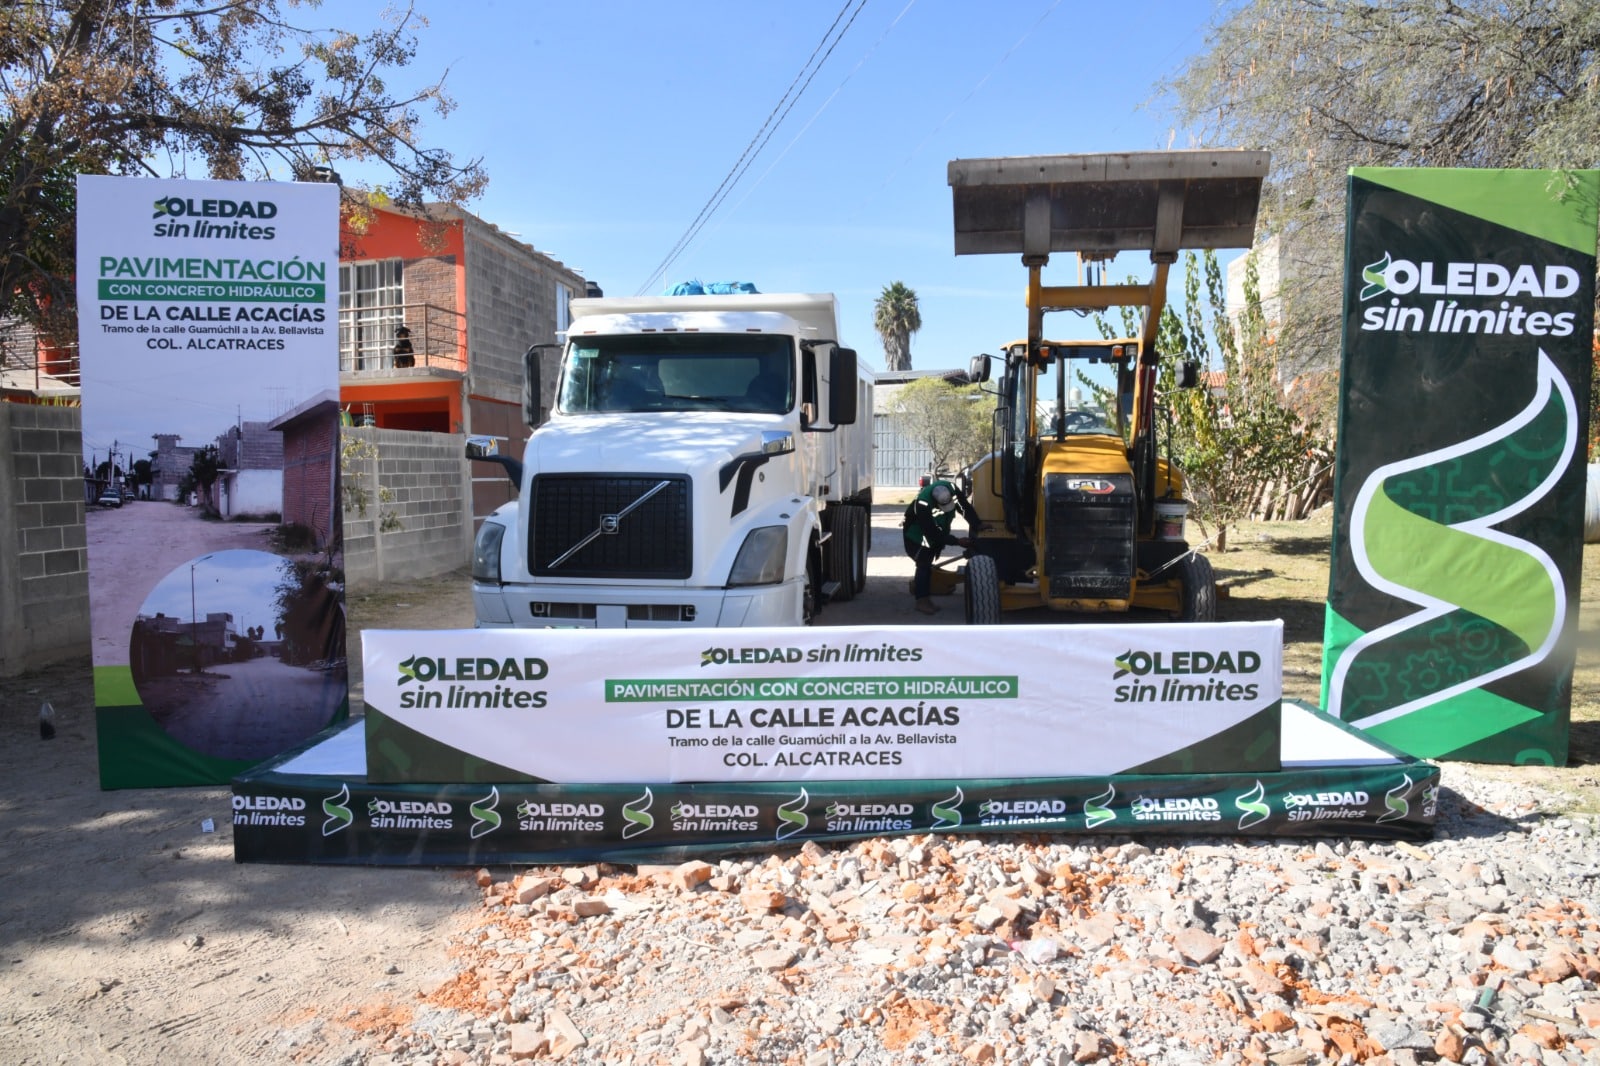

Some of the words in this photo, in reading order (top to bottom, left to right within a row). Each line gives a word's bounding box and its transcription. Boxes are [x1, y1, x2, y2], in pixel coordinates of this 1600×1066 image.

[152, 195, 278, 219] SOLEDAD
[153, 219, 190, 238] sin
[193, 221, 276, 241] límites
[99, 255, 326, 282] PAVIMENTACIÓN
[1360, 250, 1581, 302] SOLEDAD
[108, 283, 142, 296] CON
[144, 284, 226, 297] CONCRETO
[228, 283, 316, 298] HIDRÁULICO
[100, 305, 129, 321] DE
[133, 306, 161, 321] LA
[165, 306, 231, 322] CALLE
[234, 304, 326, 322] ACACÍAS
[1361, 297, 1425, 332] sin
[1428, 300, 1576, 337] límites
[101, 324, 135, 334] Tramo
[135, 324, 150, 334] de
[151, 324, 161, 334] la
[162, 324, 186, 334] calle
[188, 324, 241, 335] Guamúchil
[242, 327, 249, 335] a
[250, 325, 260, 335] la
[261, 325, 277, 335] Av.
[278, 326, 324, 335] Bellavista
[146, 338, 183, 350] COL.
[186, 338, 285, 351] ALCATRACES
[700, 646, 803, 668] SOLEDAD
[806, 644, 841, 663] sin
[843, 643, 923, 663] límites
[1113, 648, 1261, 680] SOLEDAD
[398, 654, 549, 686] SOLEDAD
[400, 685, 443, 709] sin
[447, 685, 548, 709] límites
[614, 679, 755, 698] PAVIMENTACIÓN
[759, 682, 798, 697] CON
[802, 681, 900, 696] CONCRETO
[903, 678, 1011, 695] HIDRÁULICO
[1114, 679, 1157, 702] sin
[1160, 678, 1259, 702] límites
[666, 709, 702, 729] DE
[709, 709, 744, 729] LA
[749, 708, 835, 728] CALLE
[840, 702, 960, 727] ACACÍAS
[667, 736, 709, 747] Tramo
[711, 735, 729, 747] de
[731, 735, 743, 747] la
[745, 734, 776, 746] calle
[778, 733, 847, 747] Guamúchil
[849, 737, 857, 746] a
[860, 734, 872, 746] la
[874, 734, 894, 746] Av.
[896, 733, 957, 745] Bellavista
[723, 752, 768, 767] COL.
[774, 750, 903, 767] ALCATRACES
[231, 795, 306, 811] OLEDAD
[368, 797, 452, 816] SOLEDAD
[517, 800, 604, 819] SOLEDAD
[671, 800, 759, 820] SOLEDAD
[825, 801, 914, 820] SOLEDAD
[979, 798, 1066, 818] SOLEDAD
[1131, 795, 1219, 815] SOLEDAD
[1282, 792, 1369, 810] SOLEDAD
[233, 811, 249, 825] in
[250, 811, 306, 826] límites
[371, 814, 395, 828] sin
[397, 815, 453, 829] límites
[827, 816, 852, 831] sin
[854, 816, 912, 831] límites
[1288, 807, 1312, 821] sin
[1312, 807, 1367, 820] límites
[520, 817, 544, 831] sin
[547, 817, 604, 831] límites
[673, 818, 698, 831] sin
[700, 818, 758, 831] límites
